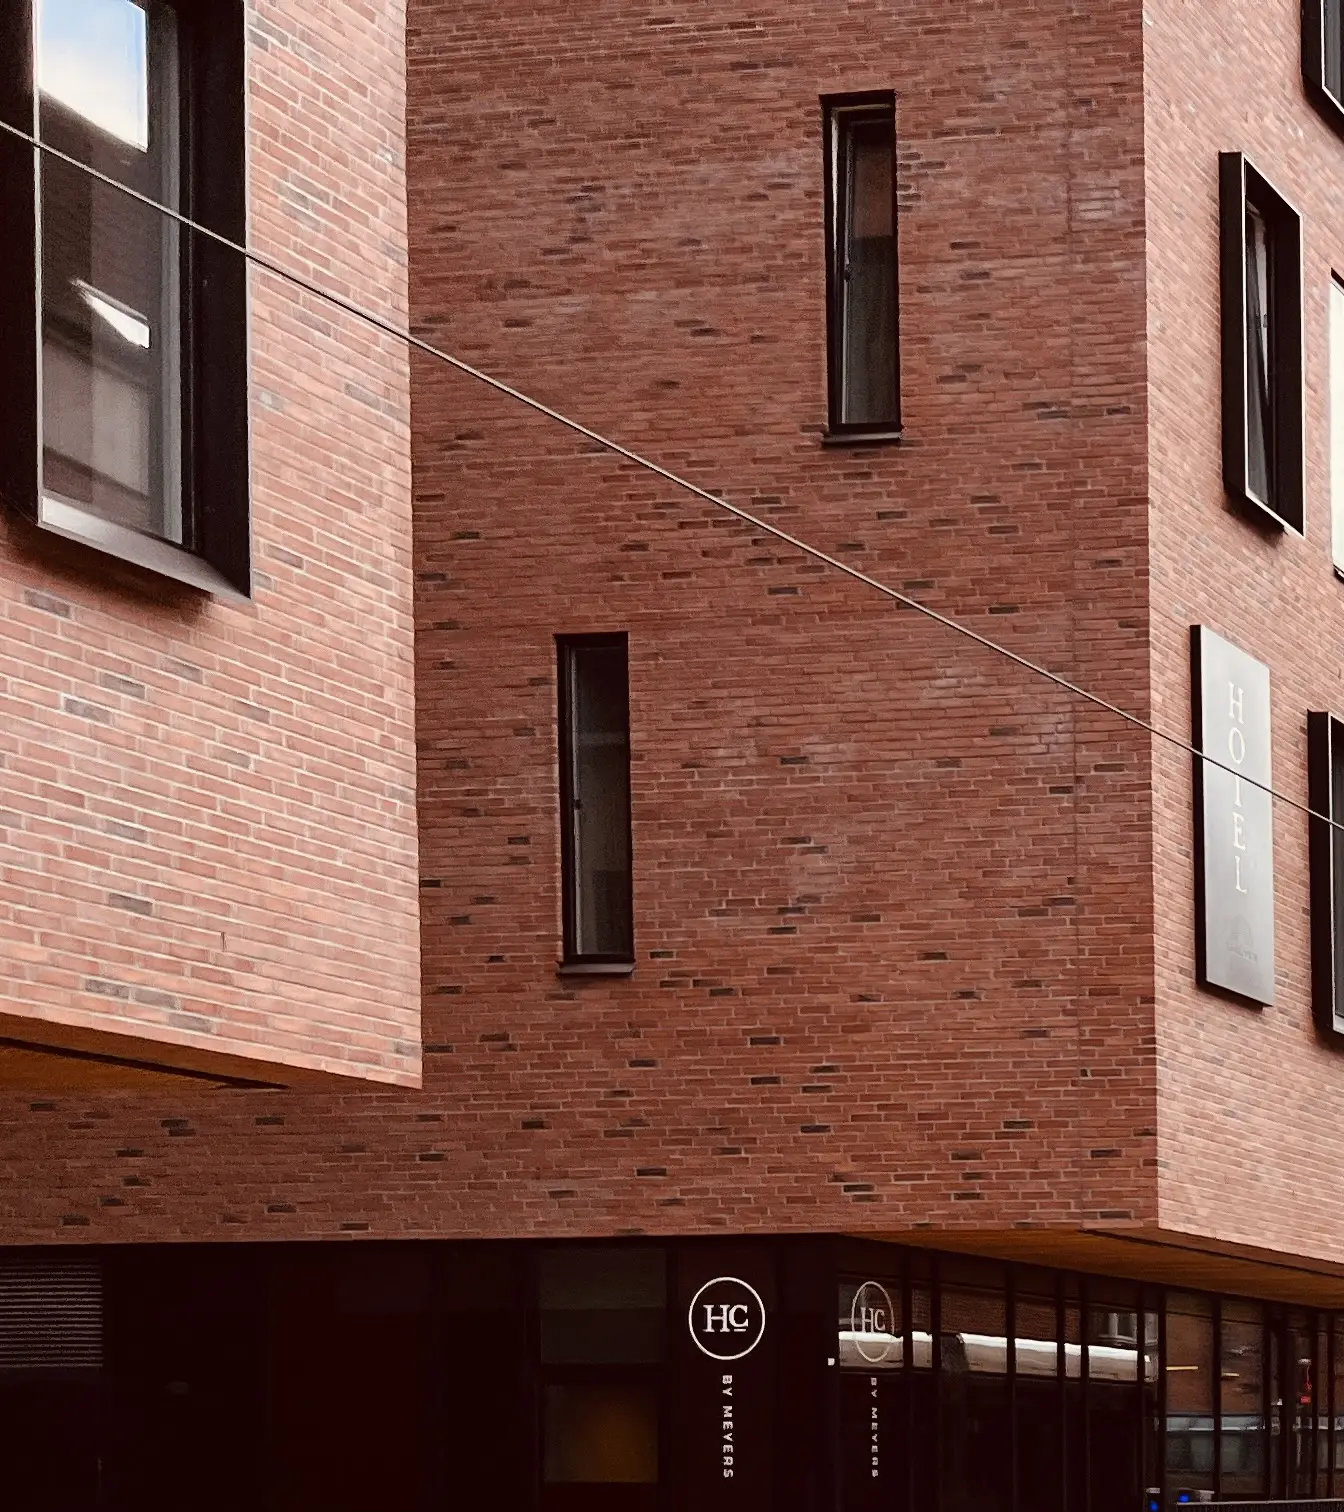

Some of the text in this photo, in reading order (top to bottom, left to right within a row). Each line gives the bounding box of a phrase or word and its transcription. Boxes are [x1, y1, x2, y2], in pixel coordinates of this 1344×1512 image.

[1228, 682, 1248, 894] HOTEL
[703, 1304, 749, 1333] HC
[860, 1307, 886, 1333] HC
[722, 1375, 734, 1478] BY MEYERS
[870, 1377, 879, 1478] BY MEYERS
